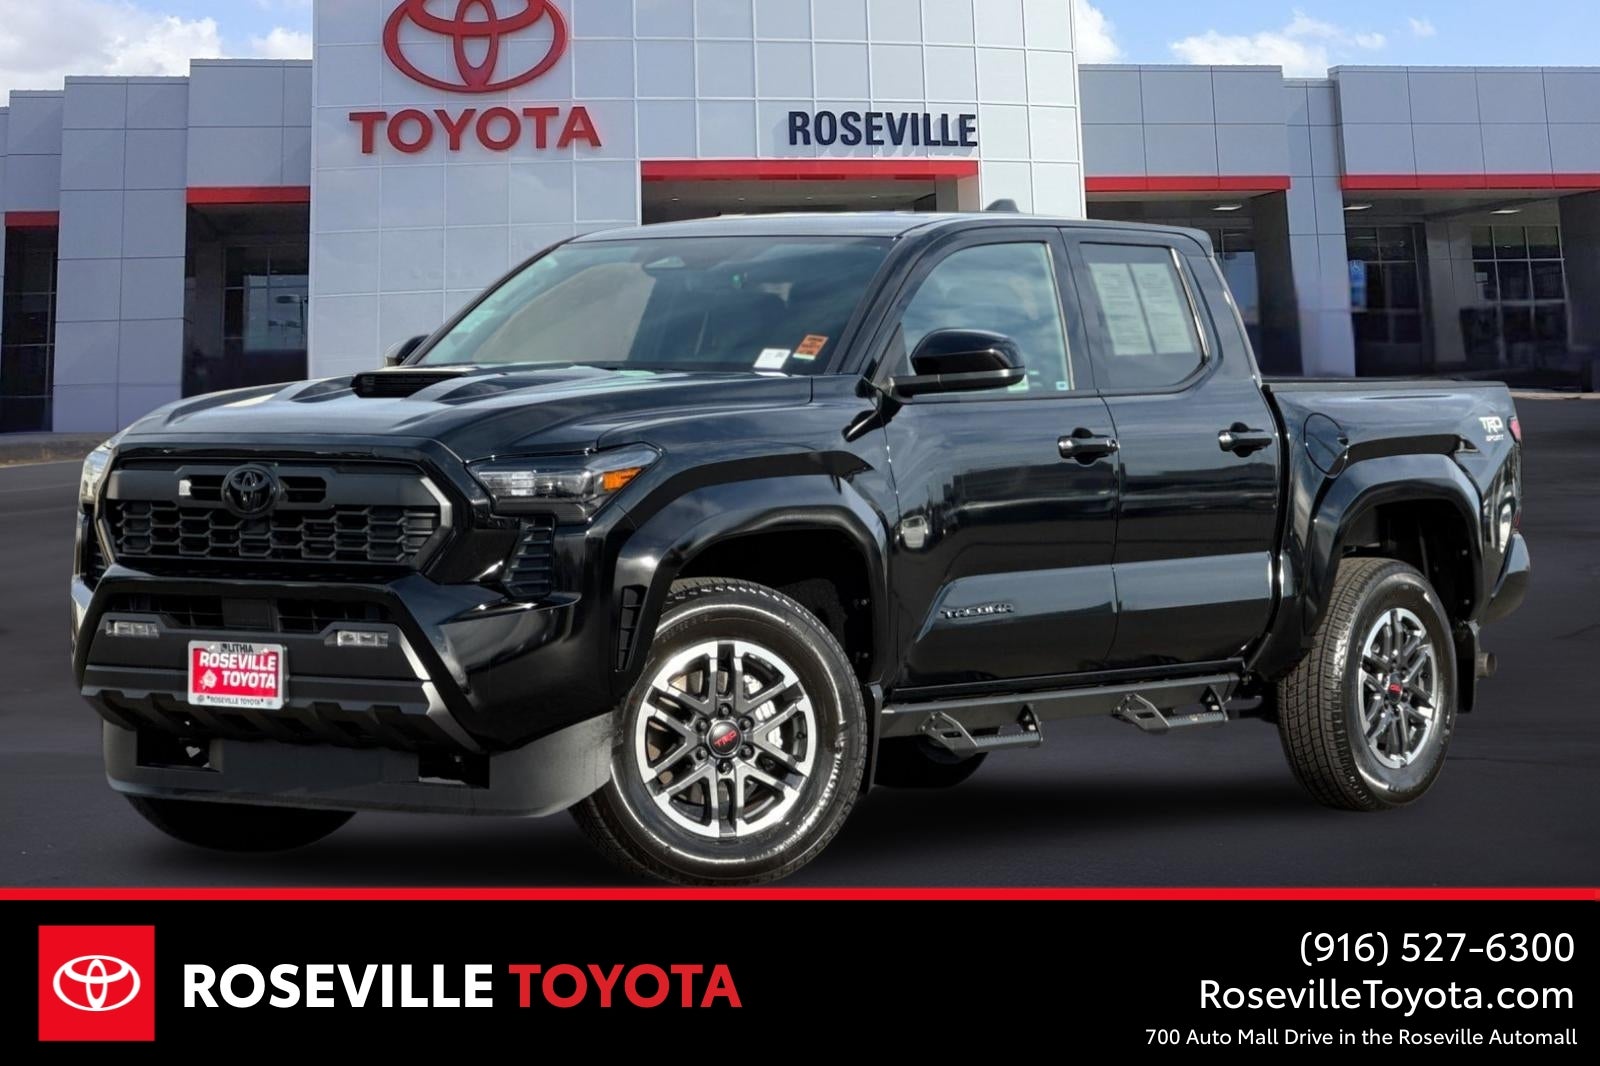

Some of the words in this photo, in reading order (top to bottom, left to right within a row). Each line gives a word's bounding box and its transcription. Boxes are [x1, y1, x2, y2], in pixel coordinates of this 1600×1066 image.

[349, 106, 602, 154] TOYOTA
[788, 110, 978, 147] ROSEVILLE
[1478, 416, 1503, 433] TRD
[199, 652, 277, 671] ROSEVILLE
[222, 671, 276, 689] TOYOTA
